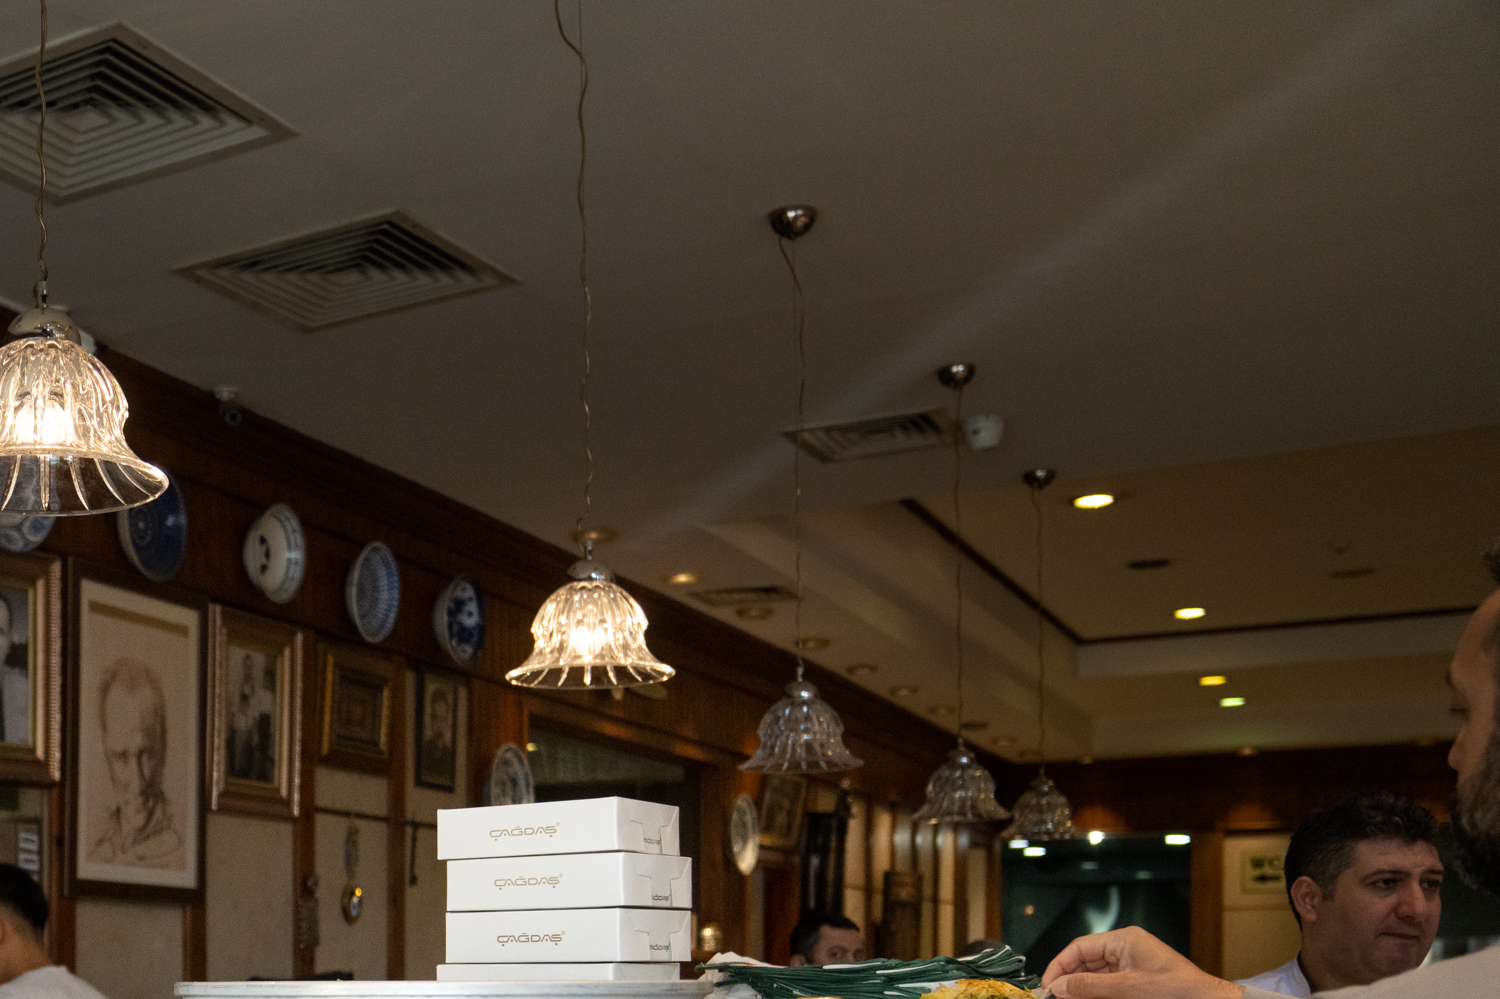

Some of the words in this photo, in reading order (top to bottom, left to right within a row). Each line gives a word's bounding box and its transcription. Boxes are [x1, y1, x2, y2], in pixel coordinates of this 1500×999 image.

[489, 825, 557, 841] ÇAĞDAŞ
[494, 876, 560, 890] ÇAĞDAŞ
[497, 932, 562, 946] ÇAĞDAŞ
